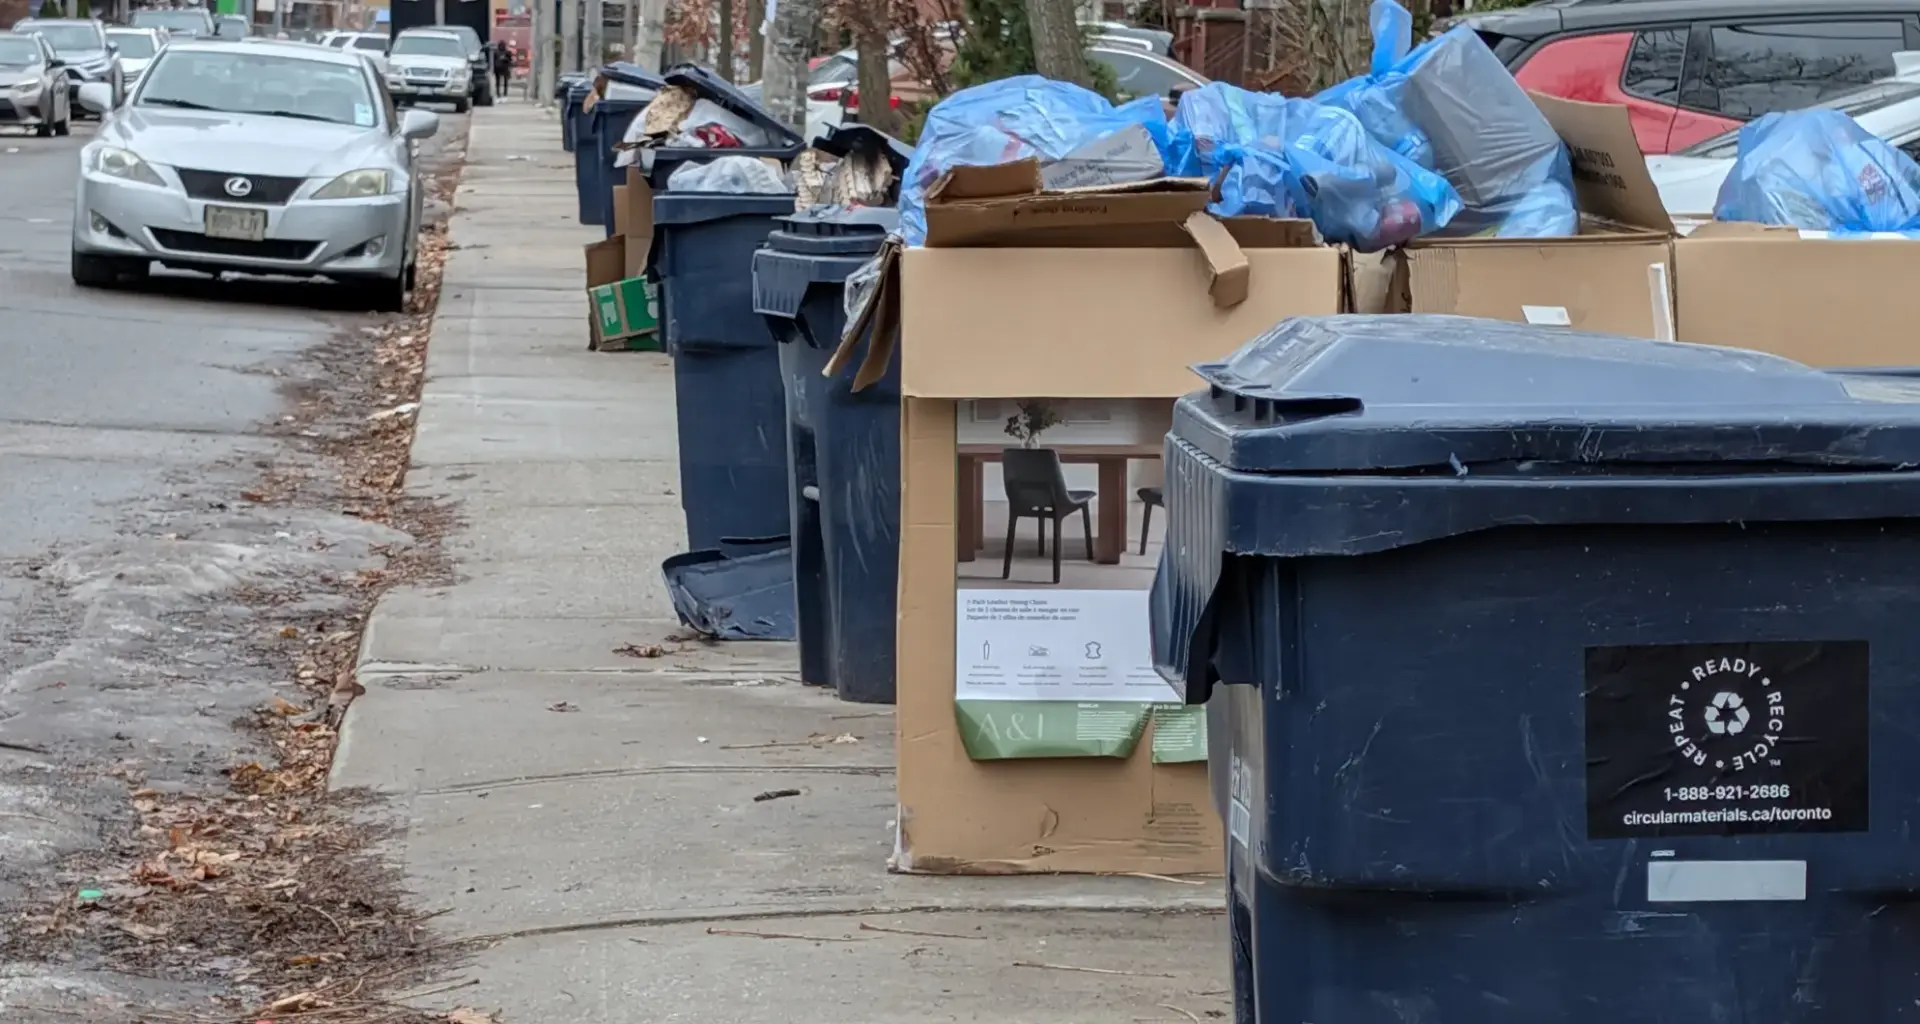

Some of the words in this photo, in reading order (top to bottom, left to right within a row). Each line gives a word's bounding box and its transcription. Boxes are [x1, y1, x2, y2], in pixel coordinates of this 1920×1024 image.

[1692, 657, 1761, 681] READY
[1669, 694, 1707, 766] REPEAT
[1732, 691, 1785, 771] RECYCLE
[1664, 784, 1790, 801] 1-888-921-2686
[1623, 806, 1832, 825] circularmaterials.ca/toronto
